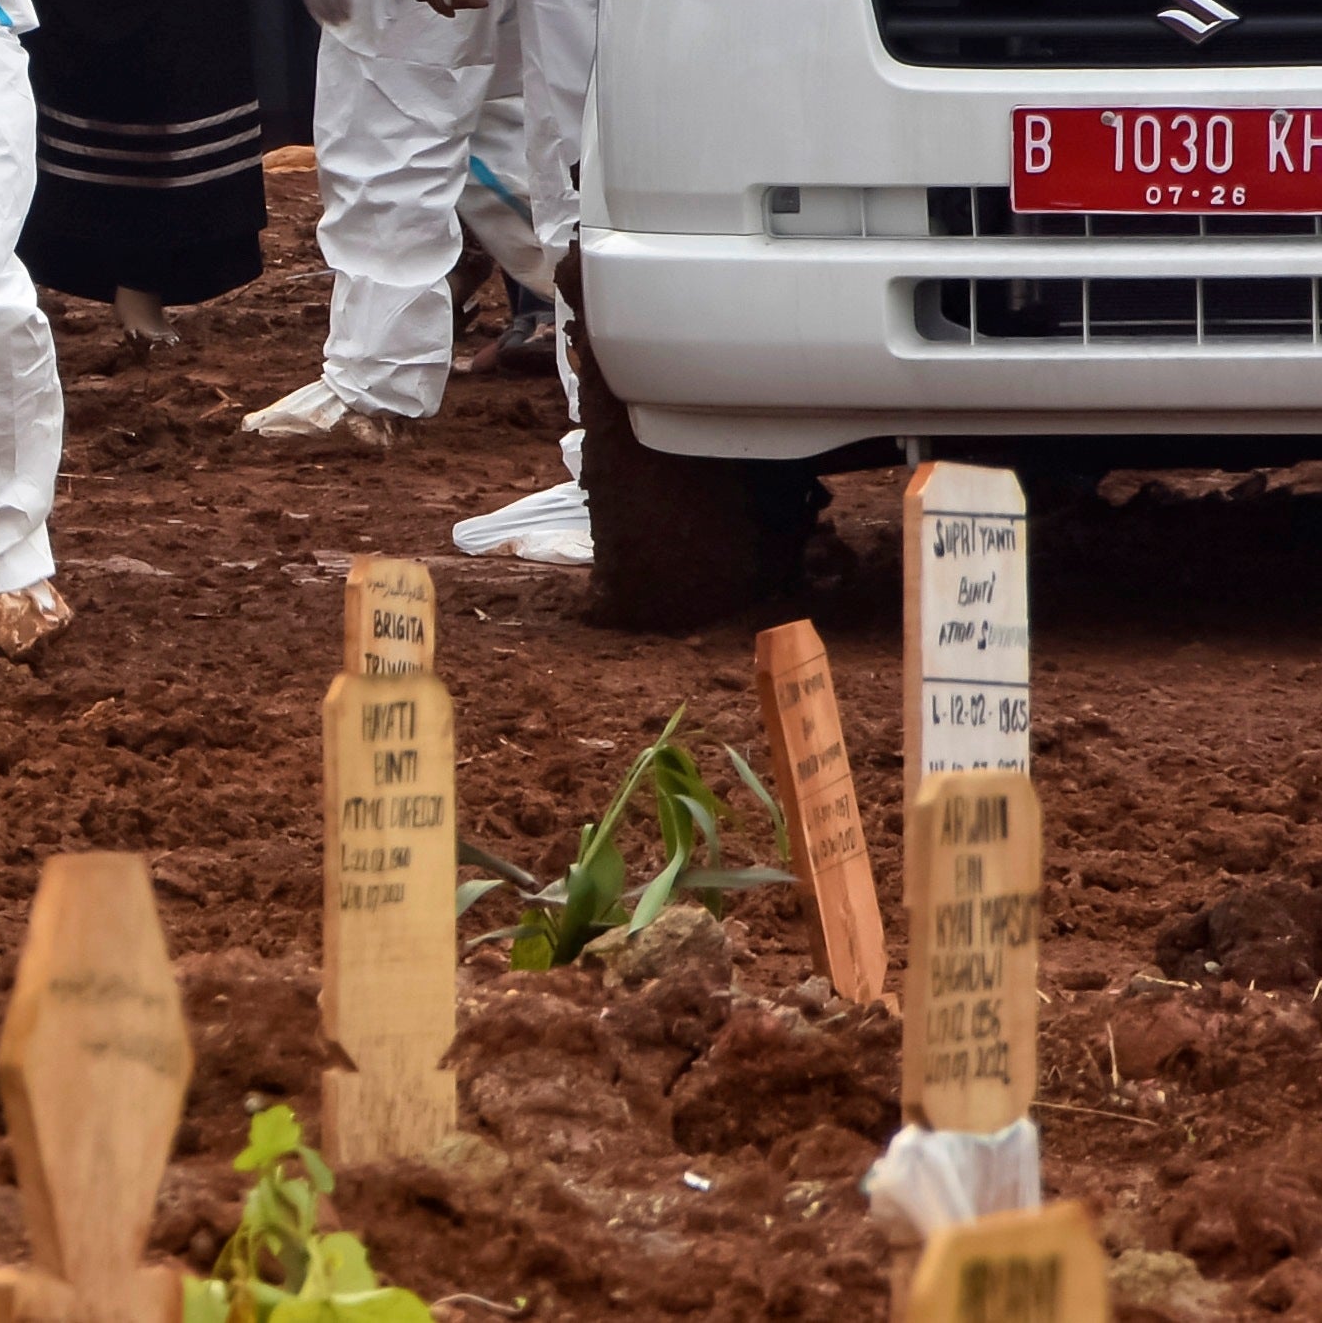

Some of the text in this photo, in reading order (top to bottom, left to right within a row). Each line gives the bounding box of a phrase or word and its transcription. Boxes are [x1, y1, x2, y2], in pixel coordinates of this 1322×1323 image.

[1025, 115, 1052, 173] B
[1111, 114, 1233, 174] 1030
[373, 609, 425, 646] BRIGITA
